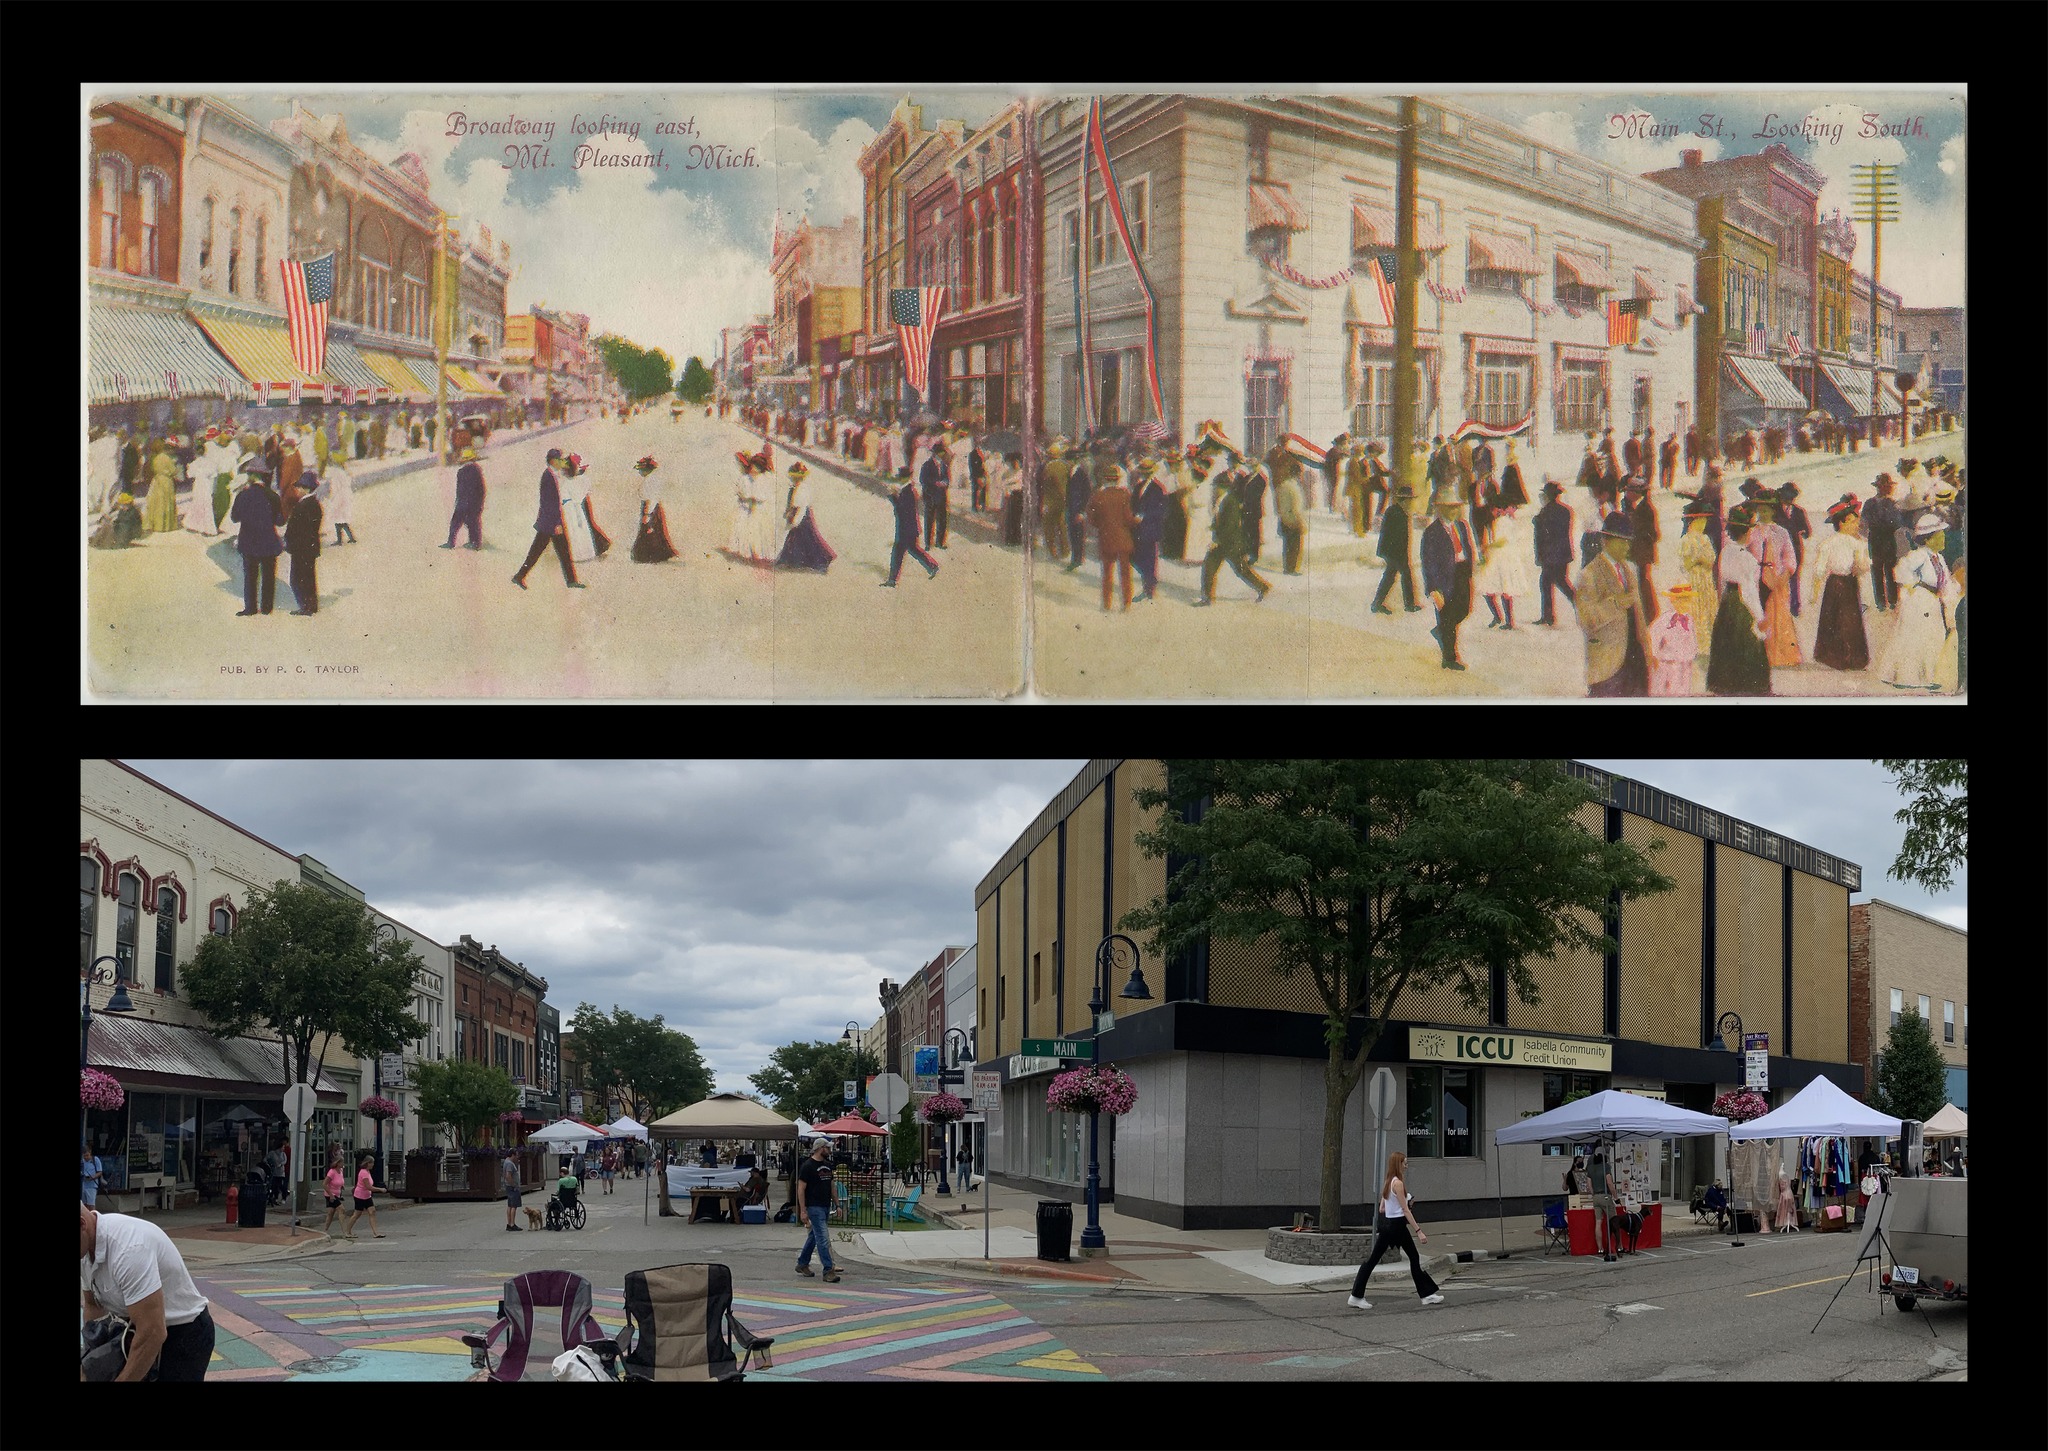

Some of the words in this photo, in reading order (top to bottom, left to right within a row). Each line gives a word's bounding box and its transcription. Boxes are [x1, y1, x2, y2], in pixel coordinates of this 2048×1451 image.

[1036, 1044, 1040, 1052] S
[1053, 1042, 1077, 1056] MAIN
[1456, 1035, 1514, 1060] ICCU
[1523, 1038, 1557, 1052] Isabella
[1559, 1041, 1607, 1058] Community
[1523, 1052, 1550, 1064] Credit
[1552, 1054, 1577, 1066] Union
[1447, 1128, 1456, 1136] for
[1457, 1128, 1469, 1136] life!
